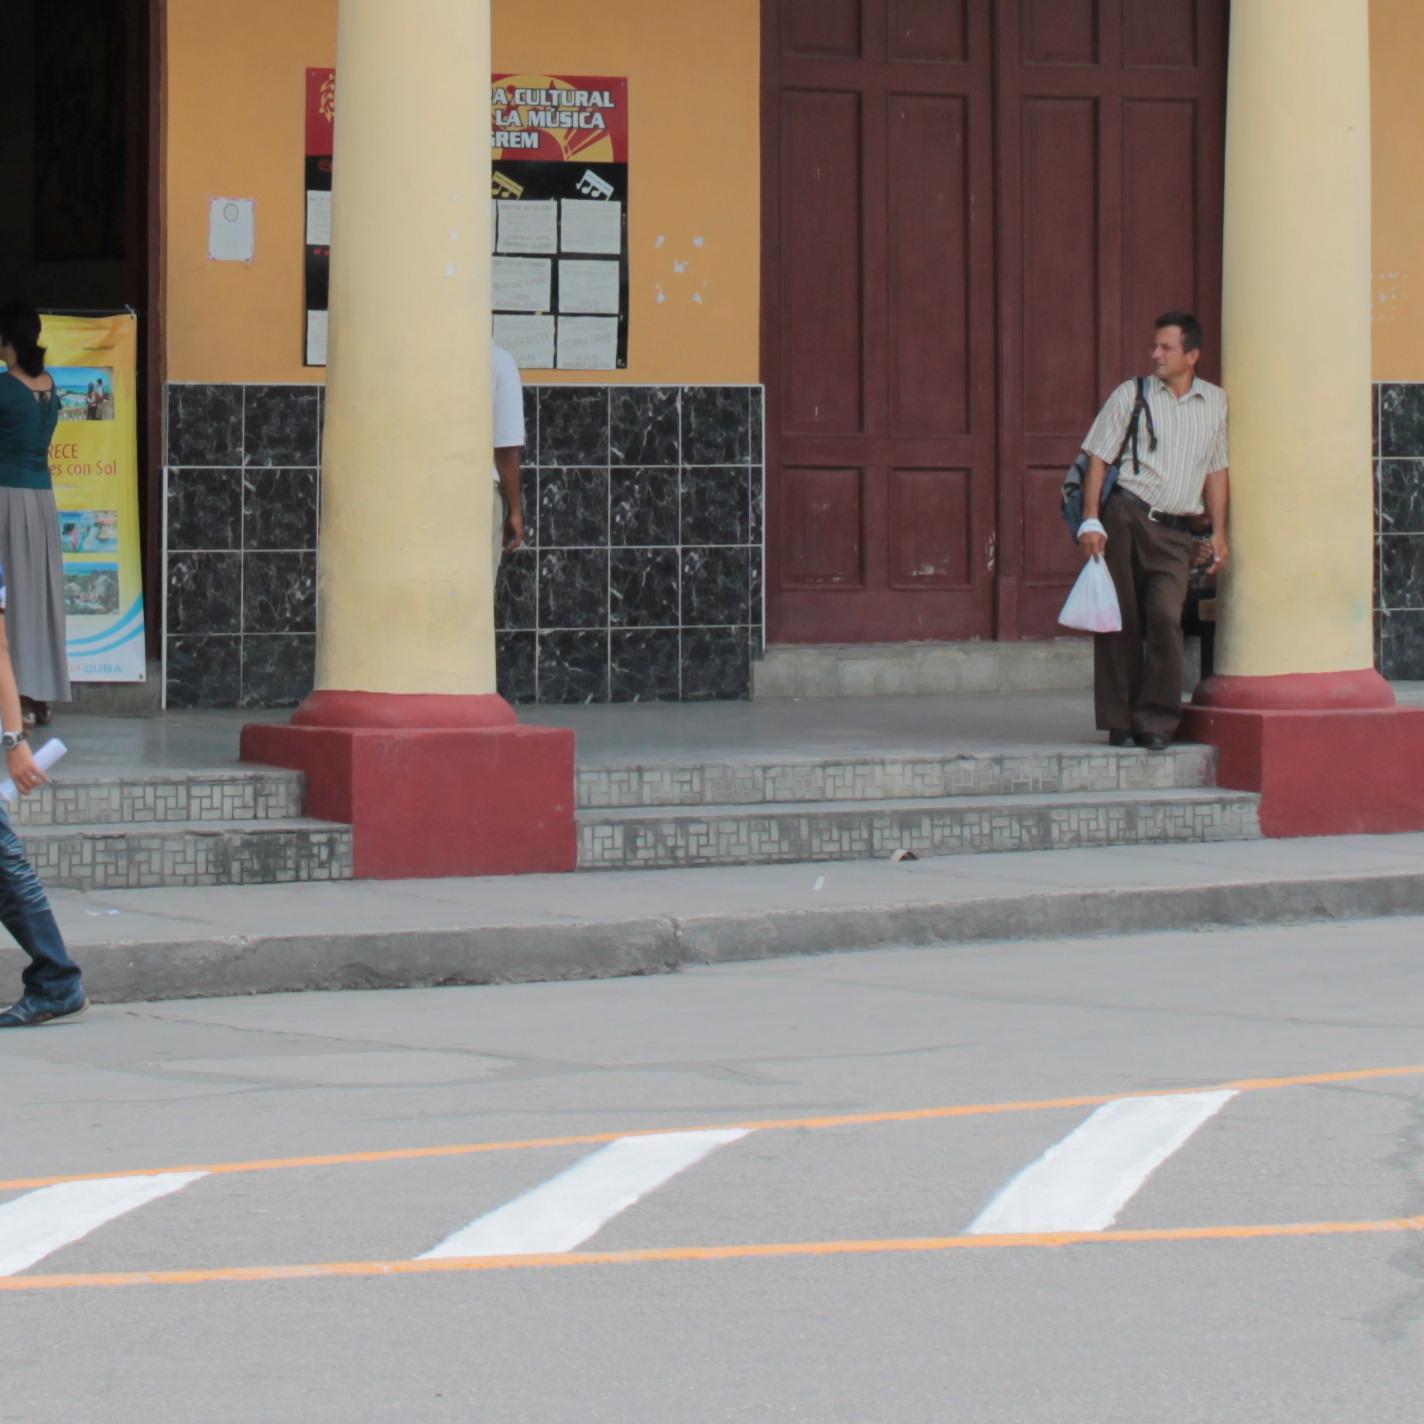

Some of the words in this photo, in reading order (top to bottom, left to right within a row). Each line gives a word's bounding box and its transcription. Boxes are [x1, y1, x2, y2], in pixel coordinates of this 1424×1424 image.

[514, 87, 615, 108] CULTURAL
[496, 109, 523, 128] LA
[527, 105, 607, 130] MÚSICA
[66, 463, 91, 476] con
[95, 459, 117, 476] Sol
